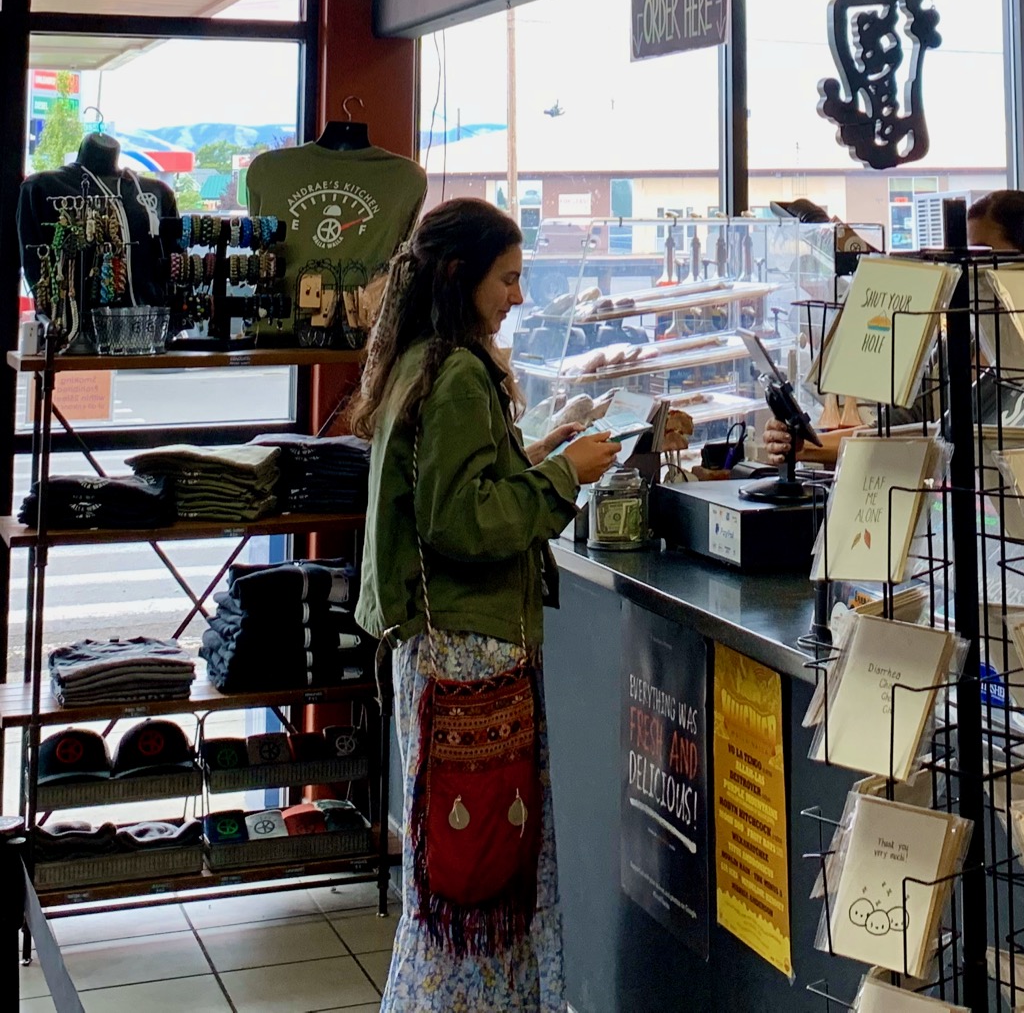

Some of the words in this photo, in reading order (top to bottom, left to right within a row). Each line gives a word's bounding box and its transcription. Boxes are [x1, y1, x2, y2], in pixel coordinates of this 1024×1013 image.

[287, 180, 340, 207] ANDRAE'S
[343, 182, 380, 214] KITCHEN
[291, 219, 300, 231] E
[358, 224, 367, 236] F
[312, 234, 326, 249] WALLA
[326, 236, 344, 249] WALLA
[861, 287, 888, 308] SHUT
[887, 292, 913, 313] YOUR
[865, 492, 878, 506] ME
[854, 507, 884, 524] ALONE
[629, 674, 676, 721] EVERYTHING
[678, 701, 698, 735] WAS
[629, 706, 664, 761] FRESH
[669, 730, 698, 781] AND
[629, 750, 698, 830] DELICIOUS!
